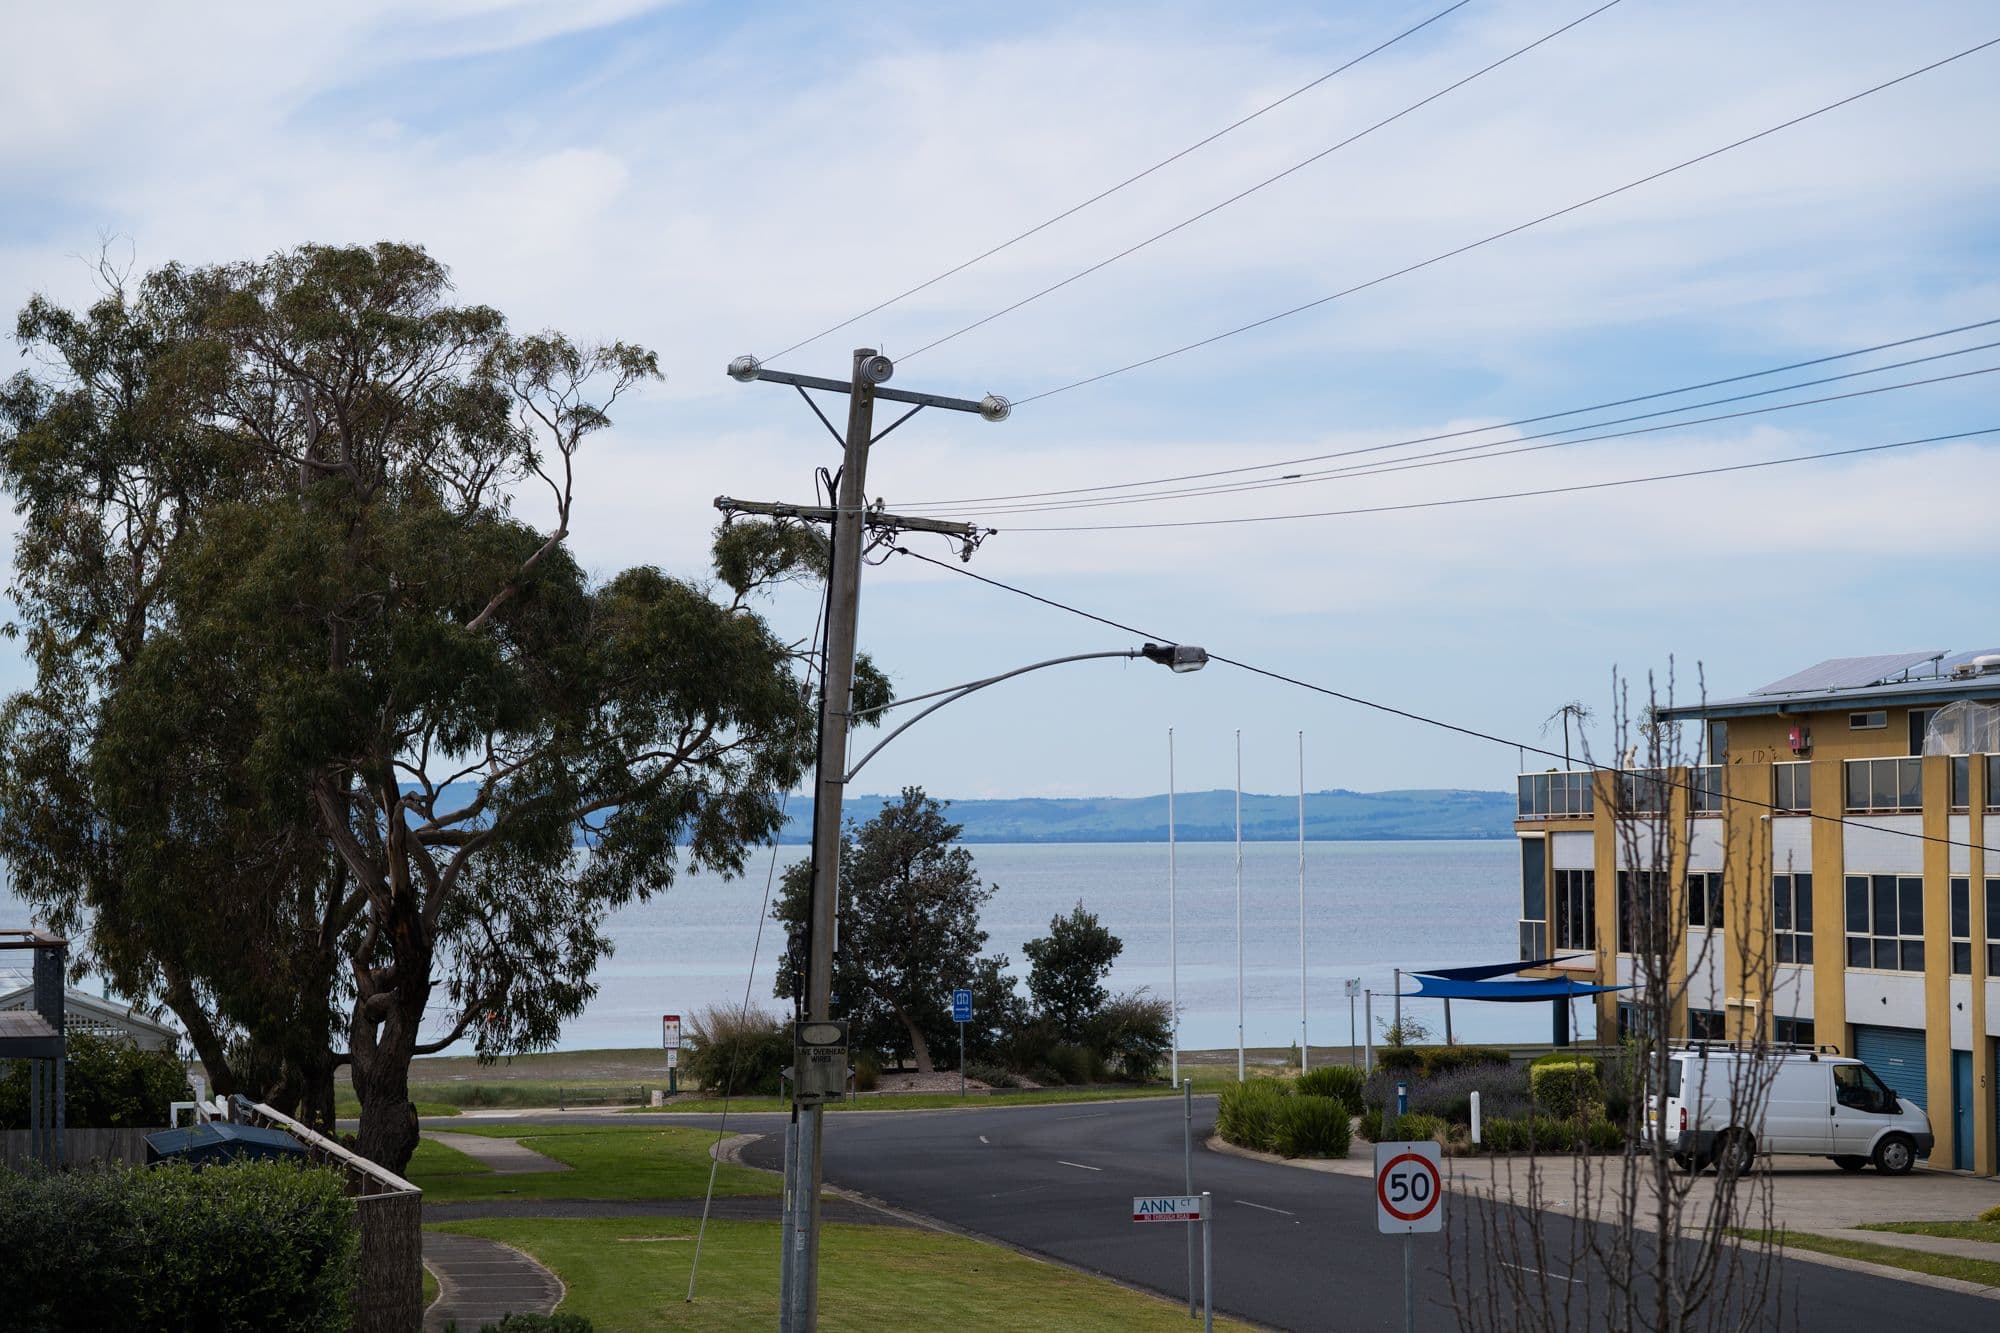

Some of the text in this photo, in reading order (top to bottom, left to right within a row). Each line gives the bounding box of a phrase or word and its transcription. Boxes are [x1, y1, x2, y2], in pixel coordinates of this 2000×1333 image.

[1391, 1172, 1430, 1202] 50
[1139, 1199, 1192, 1213] ANN CT
